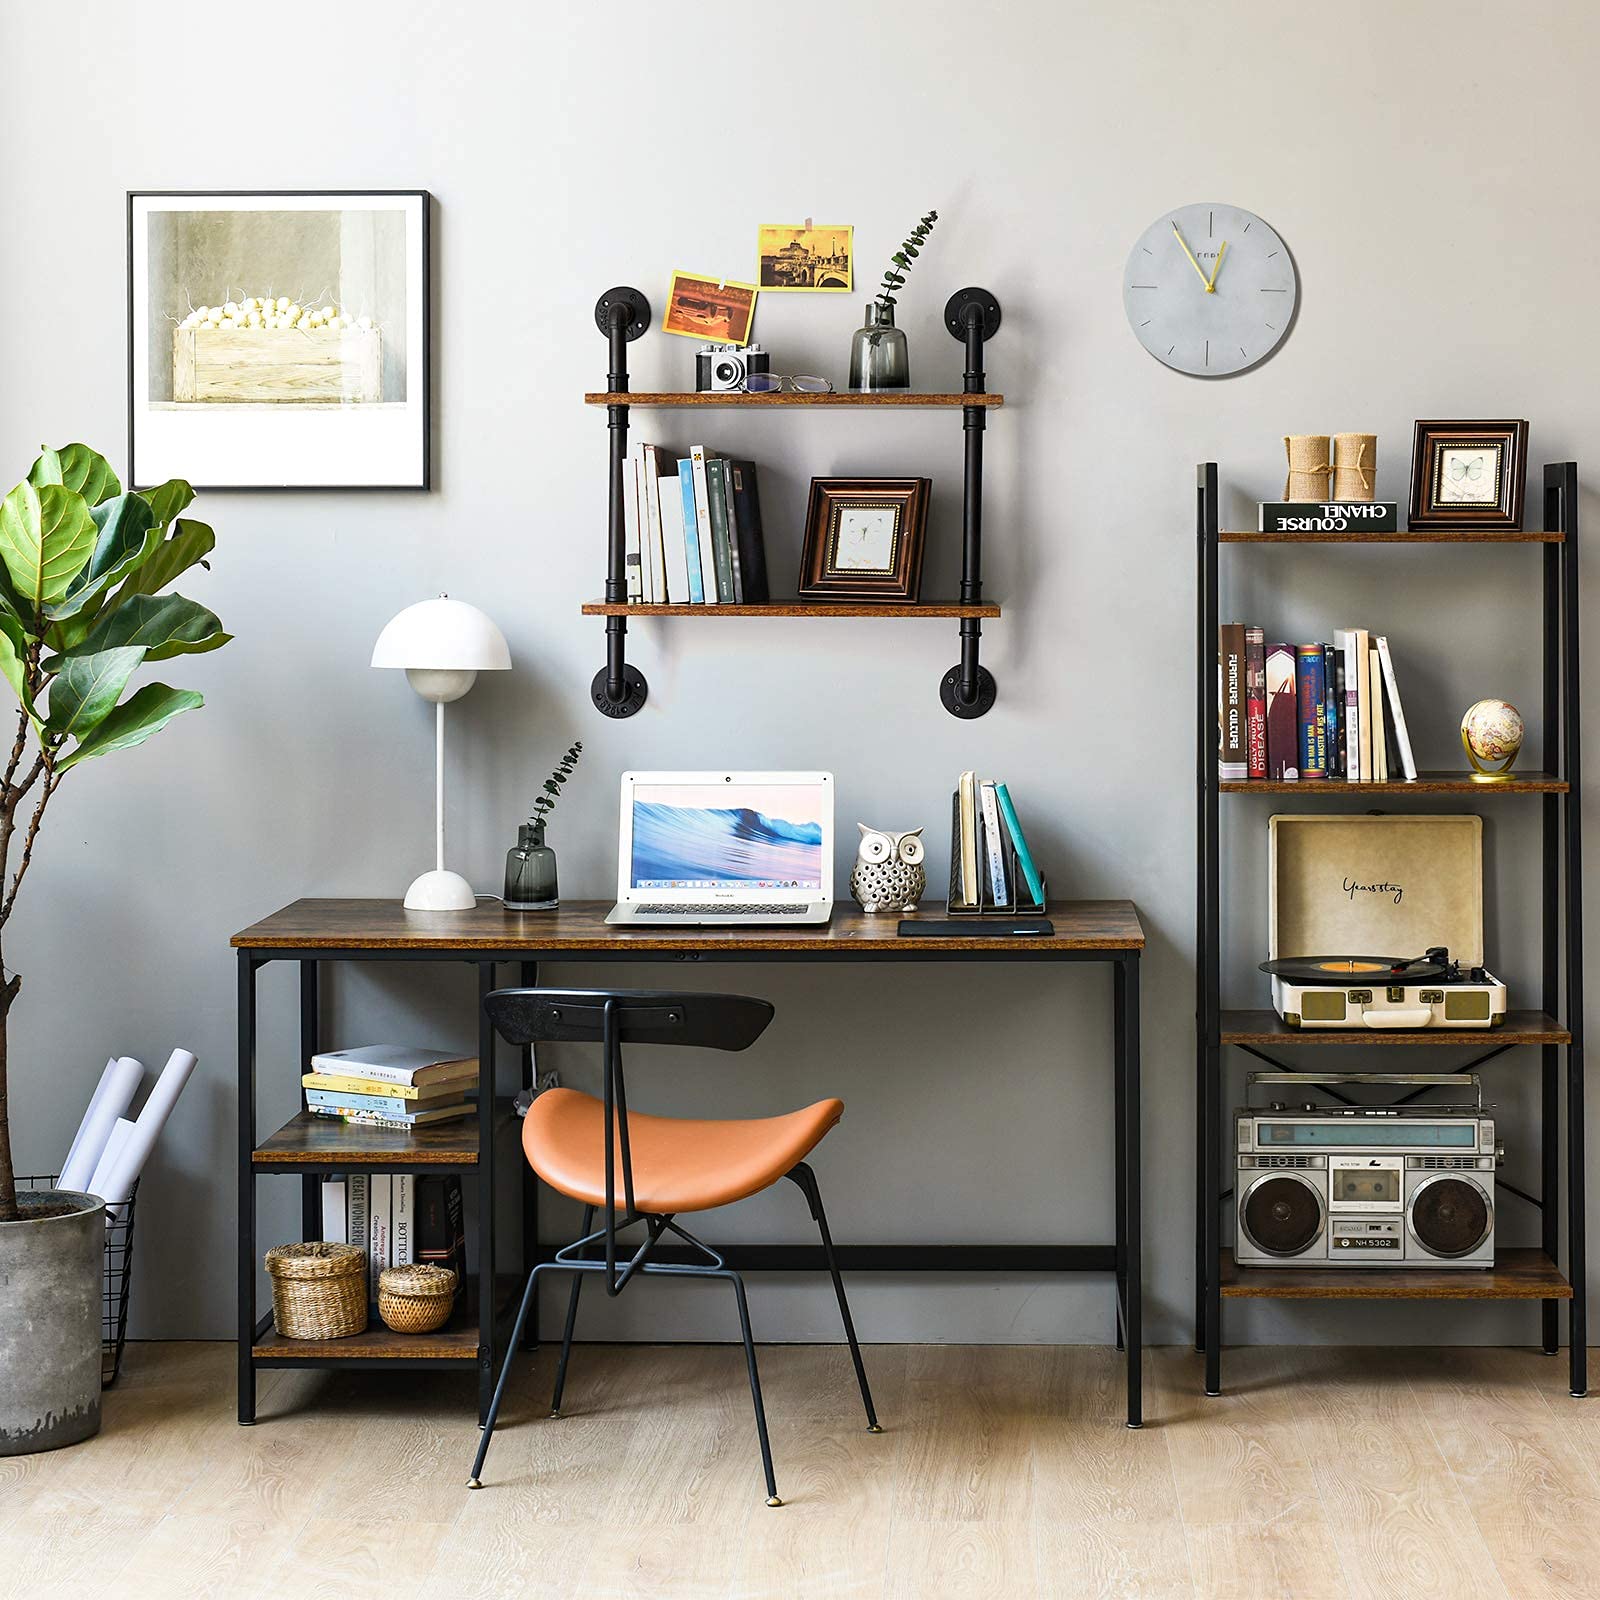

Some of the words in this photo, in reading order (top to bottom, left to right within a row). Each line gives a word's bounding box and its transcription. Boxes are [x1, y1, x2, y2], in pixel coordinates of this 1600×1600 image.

[1319, 505, 1387, 518] CHANEL
[1277, 518, 1347, 531] COURSE
[1257, 714, 1265, 770] DISEASE
[1307, 745, 1315, 757] MAN
[1317, 735, 1325, 756] MASTER
[1307, 758, 1315, 769] FOR
[352, 1176, 365, 1200] CREATE
[372, 1215, 380, 1241] Creating
[372, 1242, 380, 1252] the
[379, 1226, 387, 1255] Anderegg
[398, 1222, 408, 1268] BOTTICE
